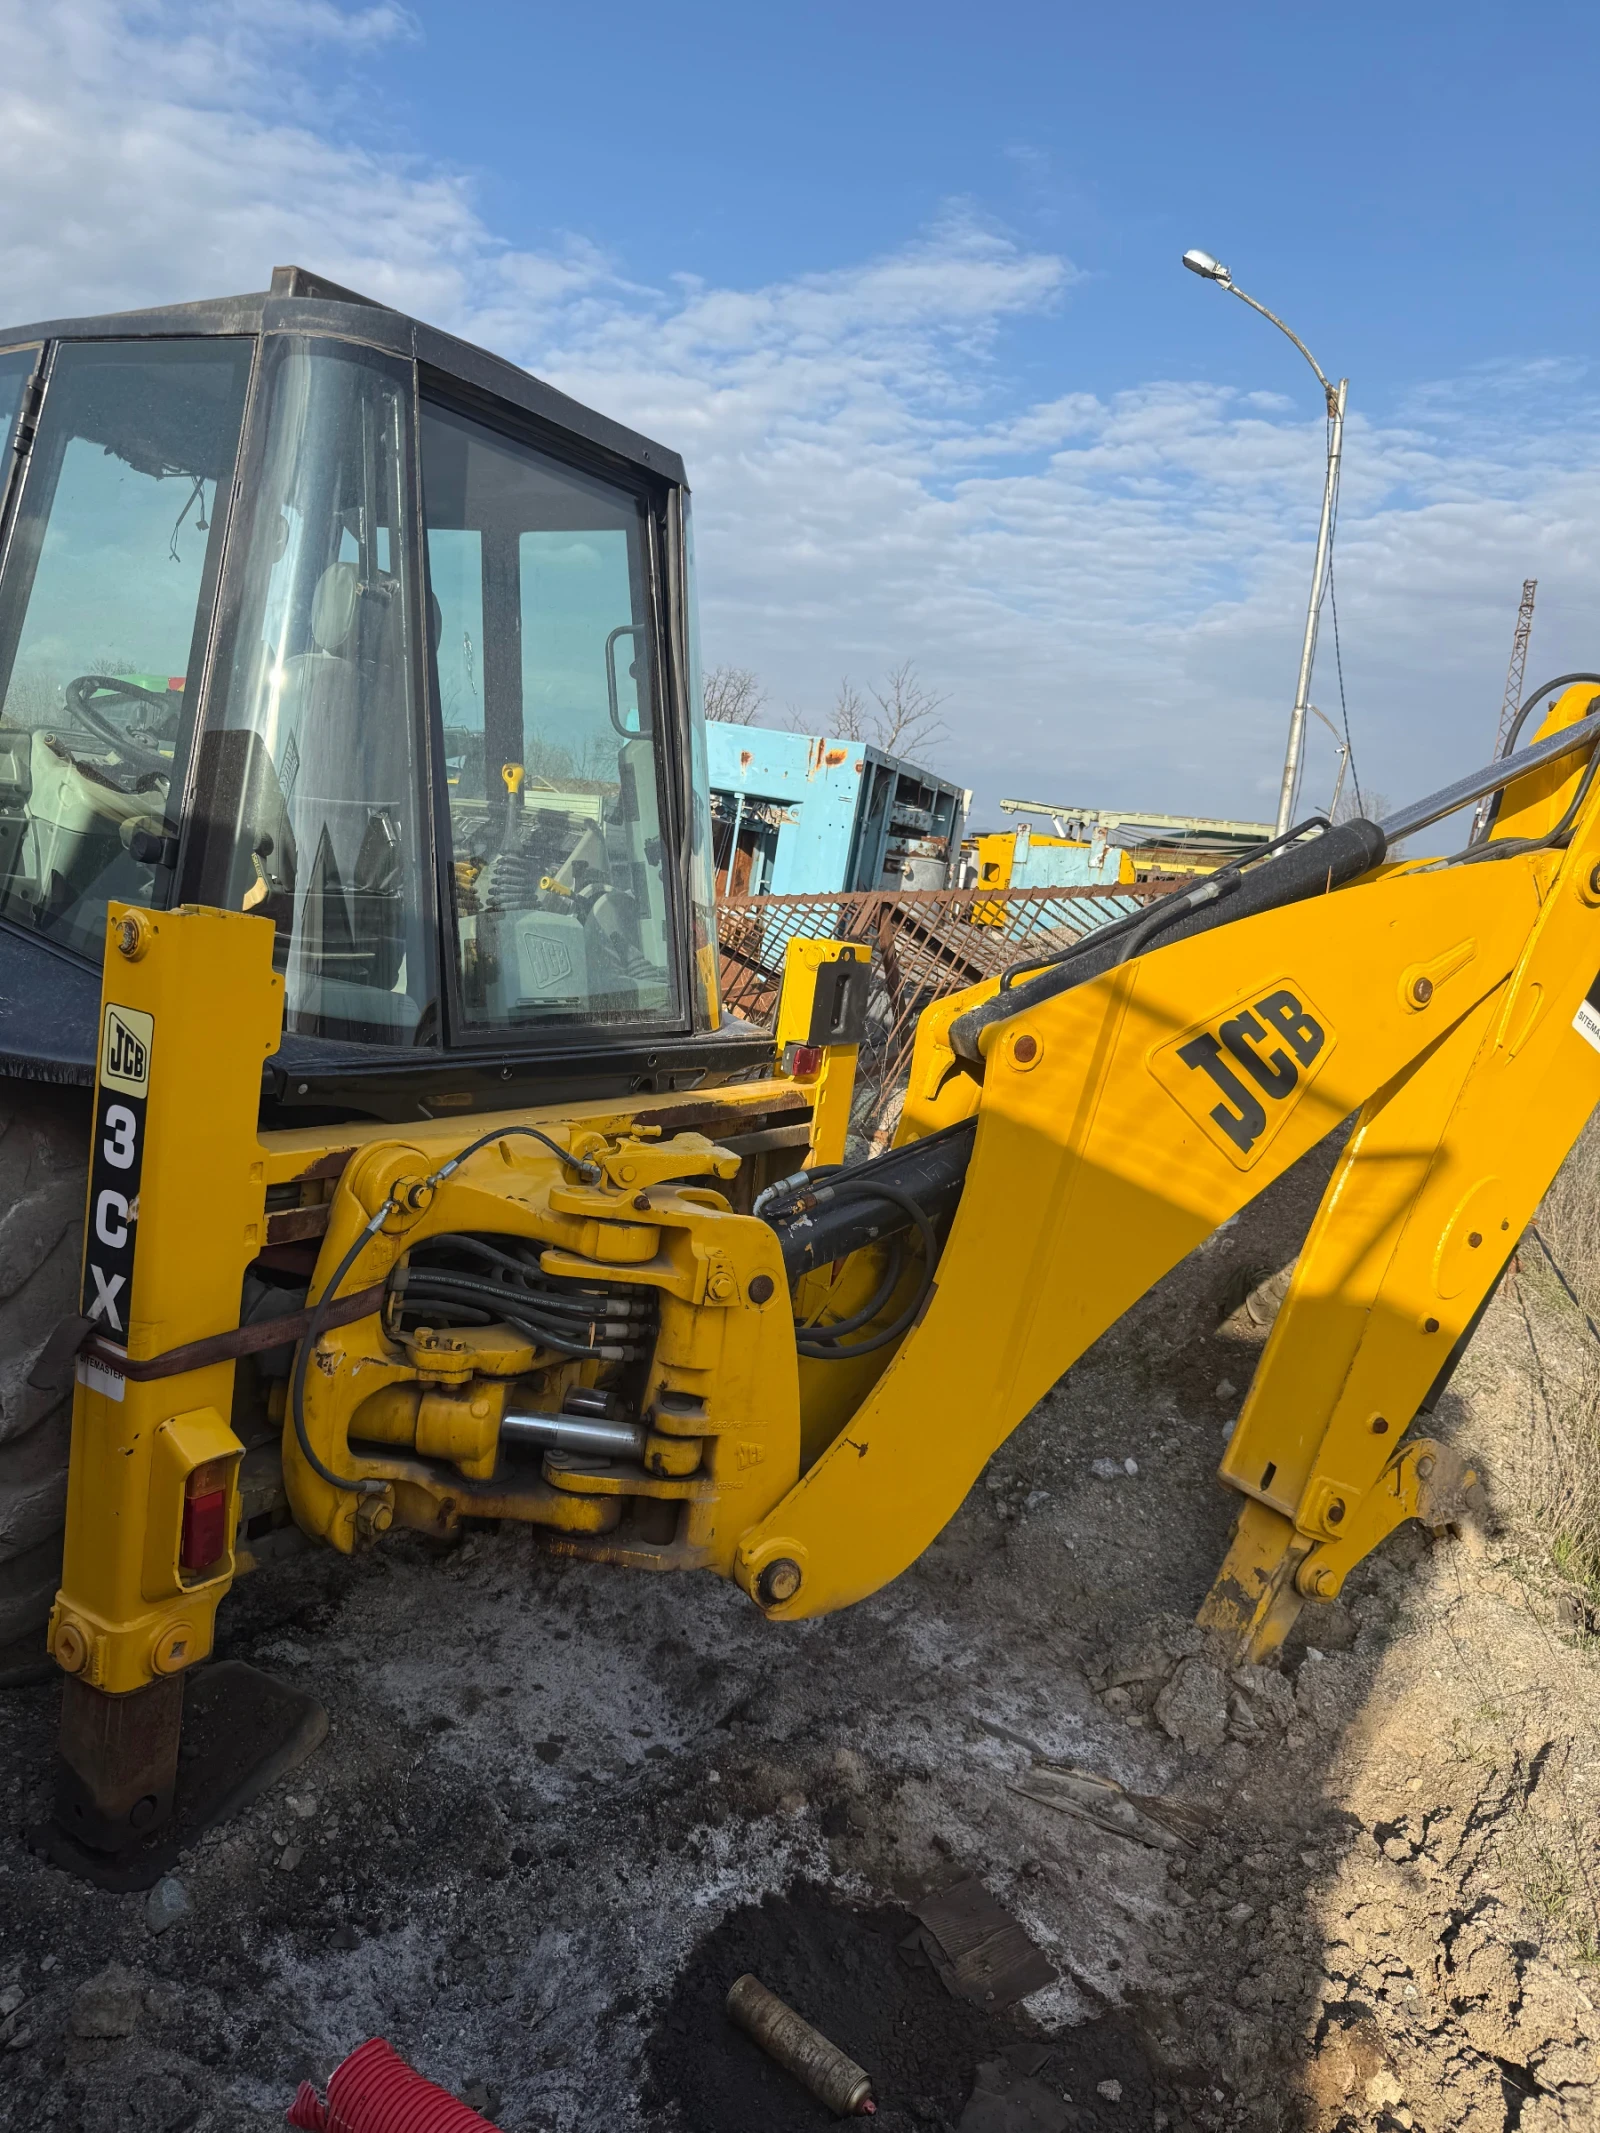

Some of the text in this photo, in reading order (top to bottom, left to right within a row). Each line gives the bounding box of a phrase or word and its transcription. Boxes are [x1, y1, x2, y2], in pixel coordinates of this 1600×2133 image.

[534, 942, 568, 982] JCB
[1578, 1011, 1600, 1041] SITEMA
[111, 1024, 146, 1080] JCB
[1176, 990, 1325, 1154] JCB
[80, 1355, 124, 1381] SITEMASTER
